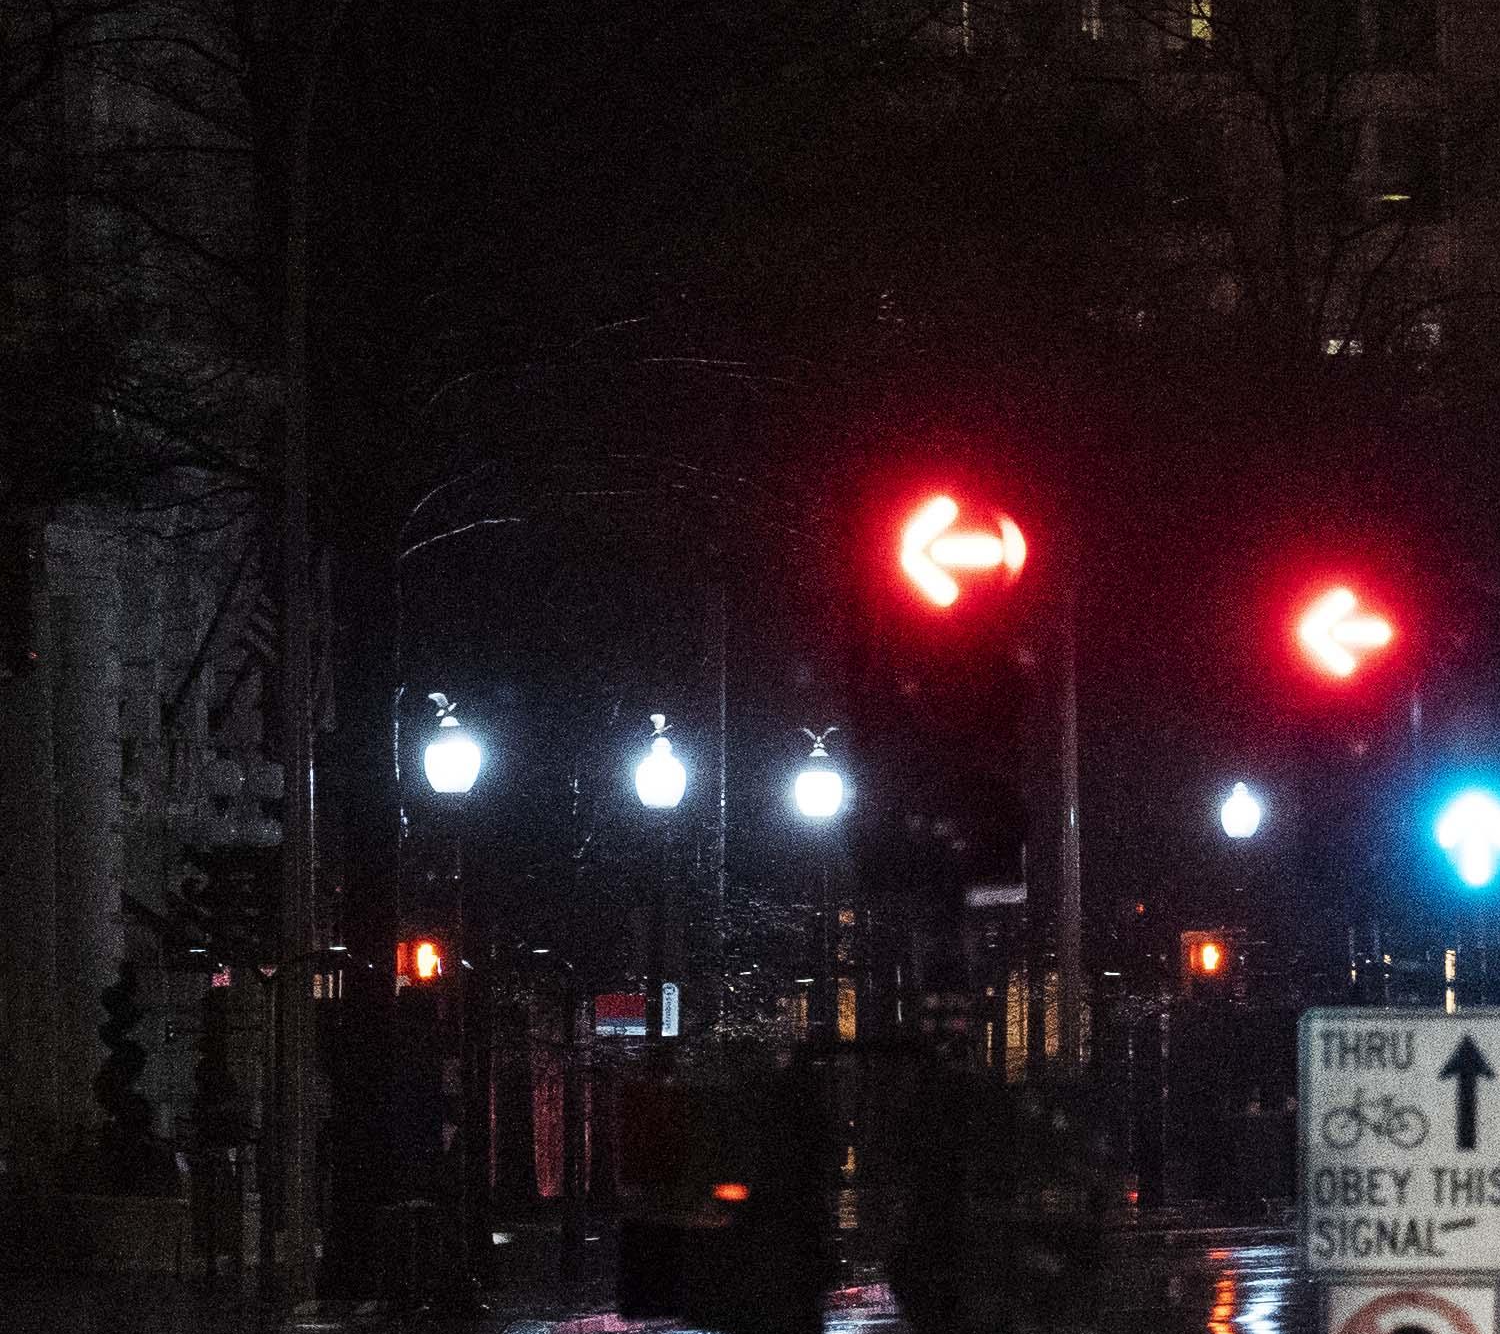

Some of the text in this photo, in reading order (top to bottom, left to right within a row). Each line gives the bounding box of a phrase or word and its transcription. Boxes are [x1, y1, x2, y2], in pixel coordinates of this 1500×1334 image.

[1320, 1030, 1415, 1071] THRU
[1315, 1166, 1412, 1208] OBEY
[1315, 1216, 1446, 1259] SIGNAL
